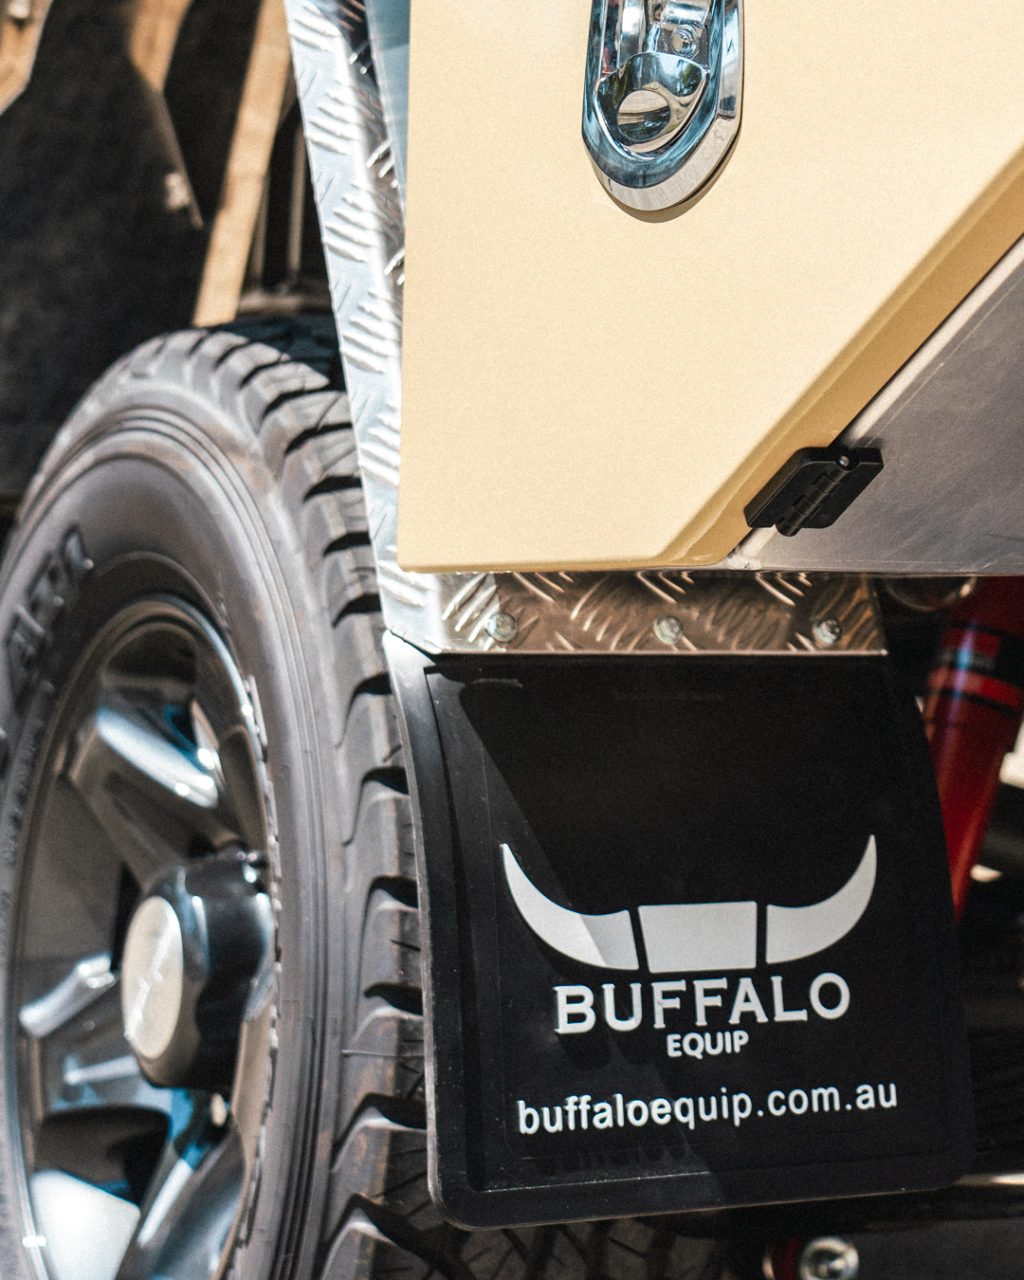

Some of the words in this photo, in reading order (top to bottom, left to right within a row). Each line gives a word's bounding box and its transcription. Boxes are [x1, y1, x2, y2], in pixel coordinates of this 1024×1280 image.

[554, 972, 851, 1034] BUFFALO
[666, 1030, 749, 1059] EQUIP
[517, 1082, 898, 1135] buffaloequip.com.au
